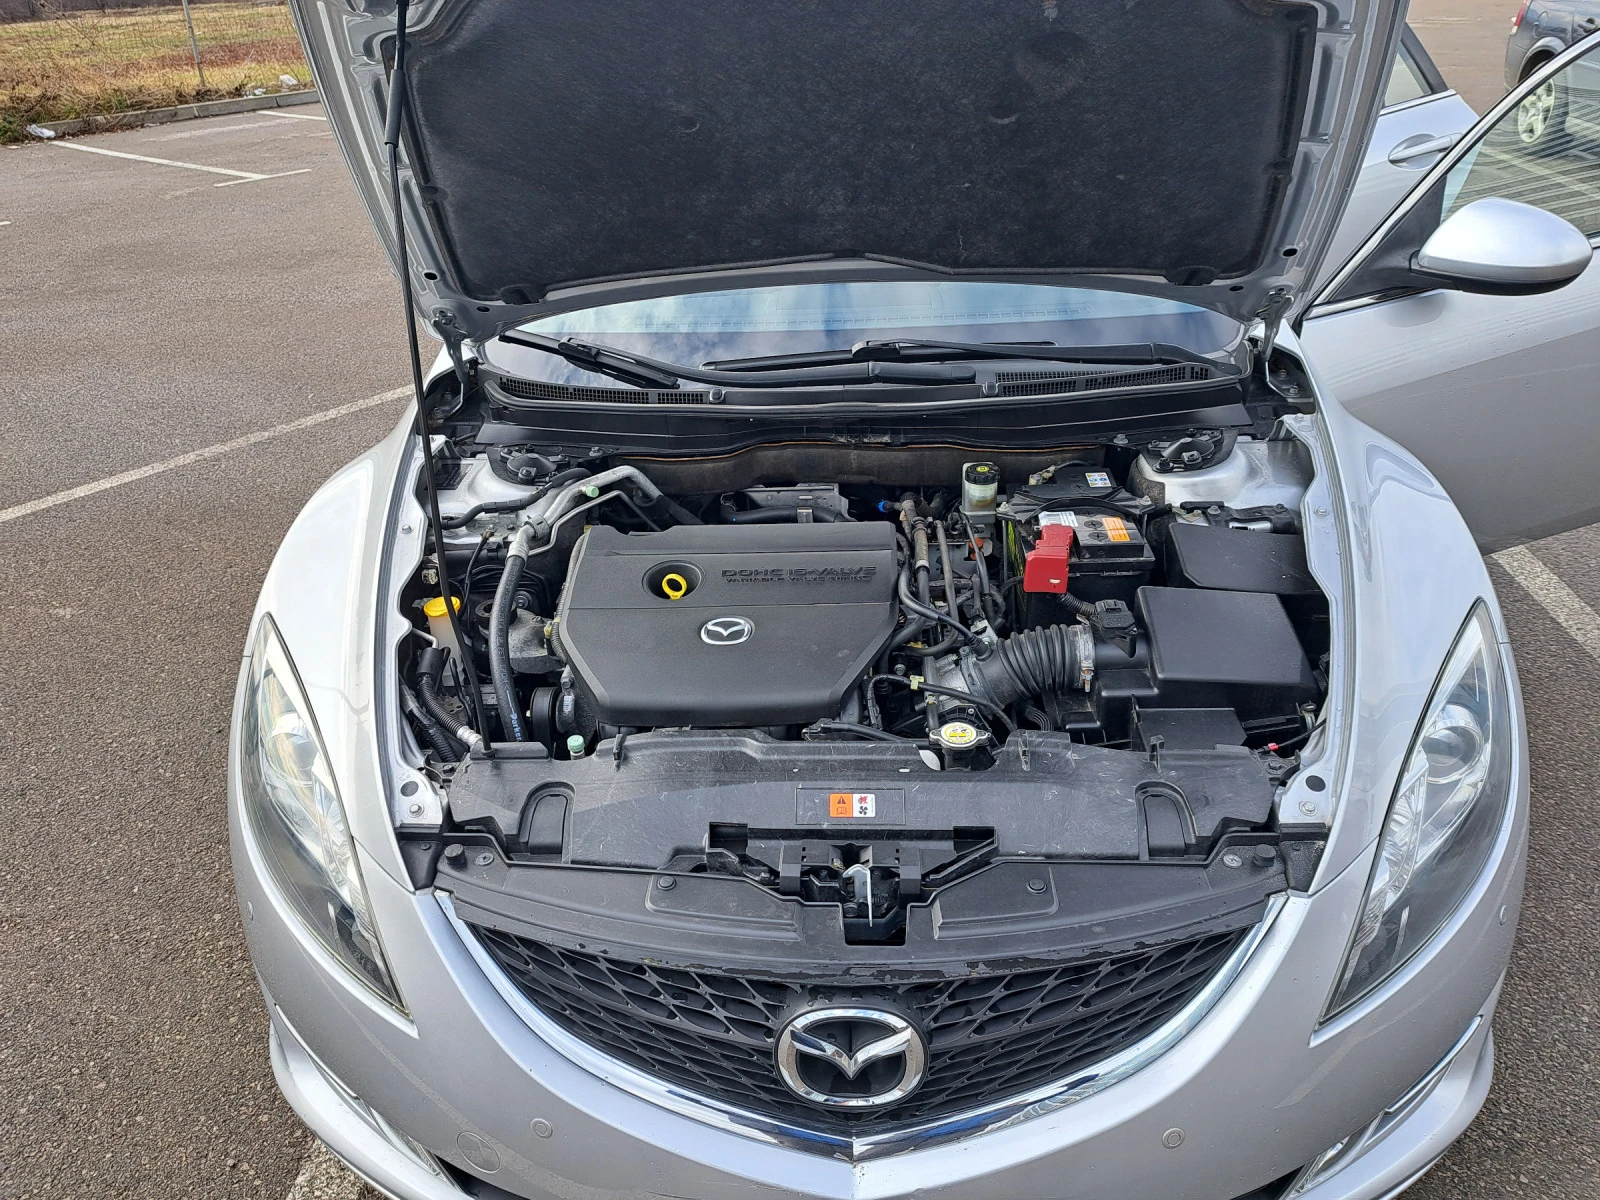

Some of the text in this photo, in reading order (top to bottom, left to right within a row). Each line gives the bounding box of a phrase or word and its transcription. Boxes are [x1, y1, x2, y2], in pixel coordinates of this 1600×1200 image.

[721, 566, 877, 577] DOHC 16-VALVE
[510, 713, 522, 741] Parker
